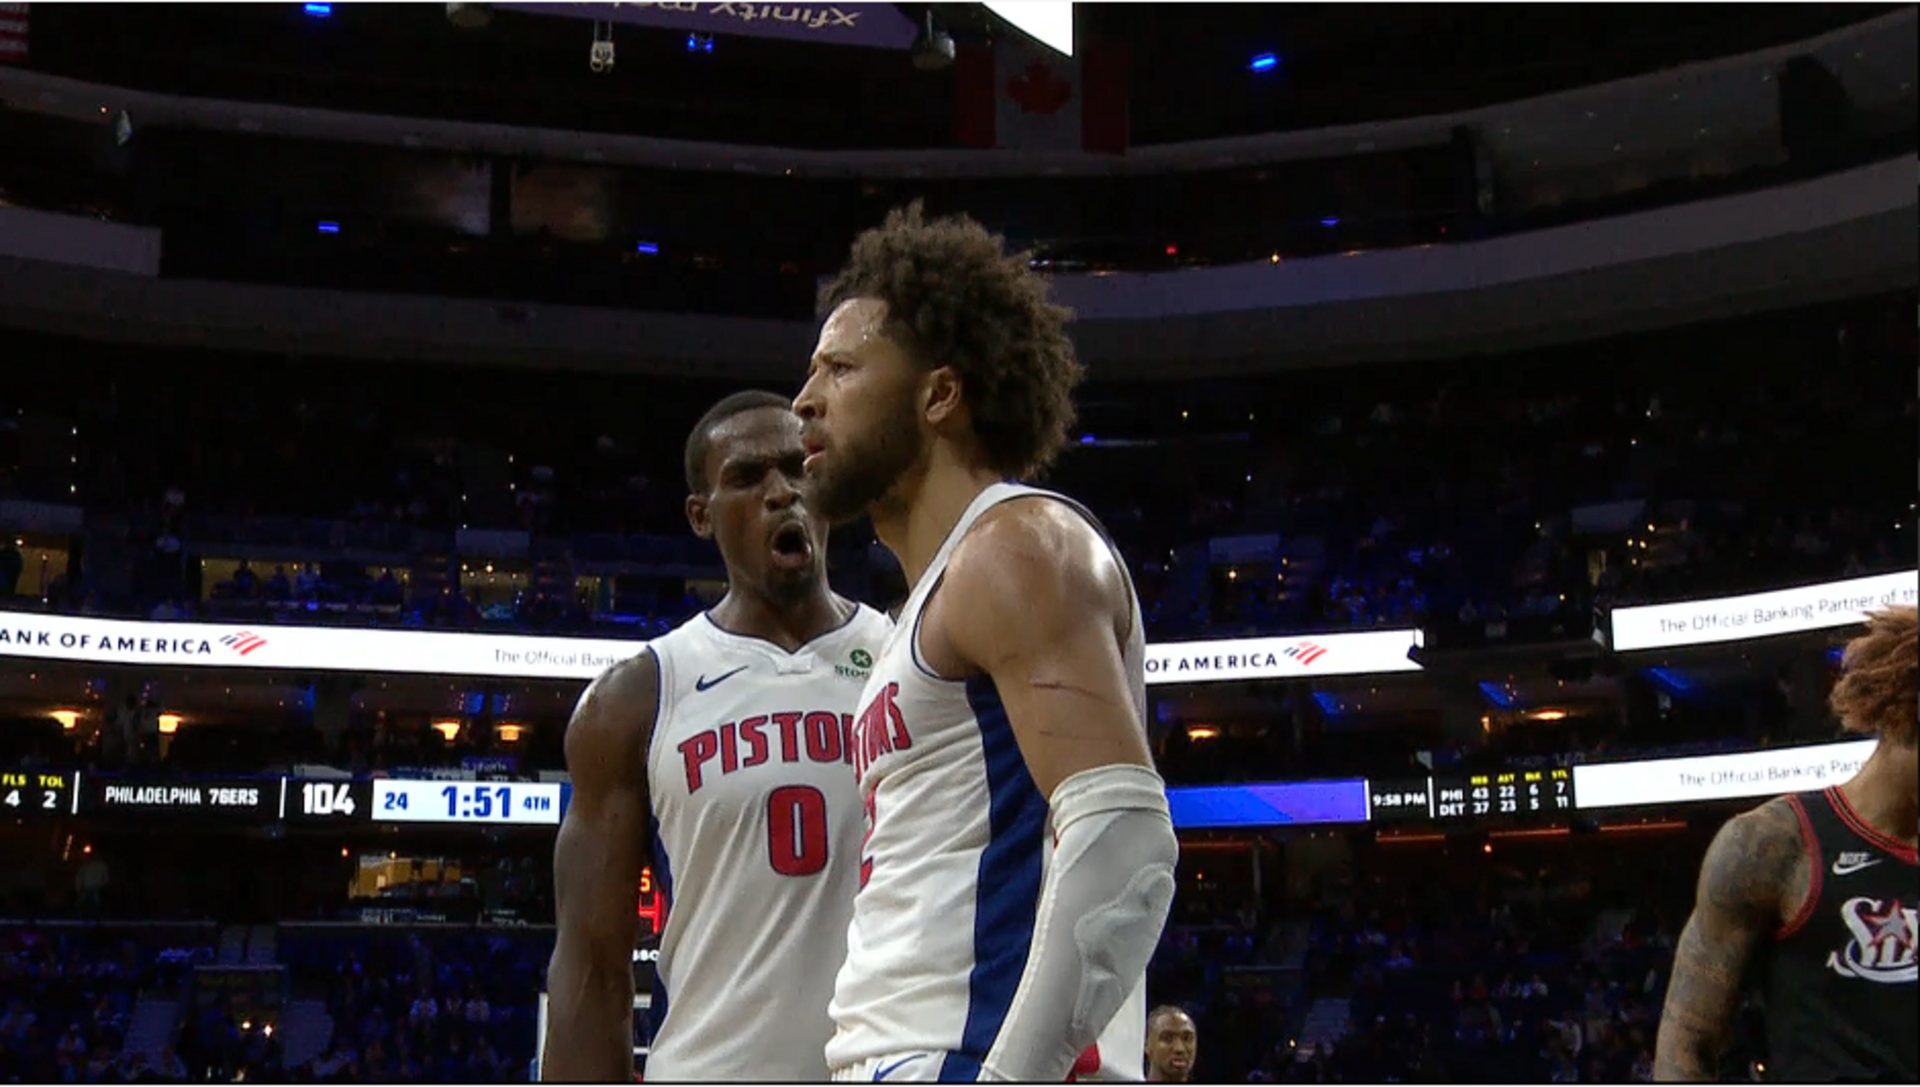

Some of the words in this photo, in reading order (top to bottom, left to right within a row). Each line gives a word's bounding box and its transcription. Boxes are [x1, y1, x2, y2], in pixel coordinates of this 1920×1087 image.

[1660, 619, 1687, 633] The
[1692, 613, 1747, 631] Official
[1753, 605, 1813, 626] Banking
[1819, 595, 1875, 614] Partner
[1880, 588, 1896, 606] of
[0, 628, 50, 646] ANK
[60, 633, 91, 650] OF
[98, 635, 212, 655] AMERICA
[495, 648, 520, 664] The
[524, 650, 577, 666] Official
[582, 652, 615, 667] Bank
[1146, 658, 1171, 674] OF
[1178, 653, 1278, 672] AMERICA
[677, 710, 854, 795] PISTO
[3, 774, 26, 787] FLS
[38, 775, 65, 788] TOL
[1680, 773, 1704, 787] The
[1711, 768, 1763, 785] Official
[1768, 764, 1826, 780] Banking
[5, 790, 21, 807] 4
[43, 791, 57, 808] 2
[105, 786, 201, 806] PHILADELPHIA
[209, 788, 259, 806] 76ERS
[302, 783, 356, 815] 104
[384, 792, 409, 810] 24
[441, 785, 512, 818] 1:51
[522, 796, 551, 811] 4TH
[1373, 793, 1401, 807] 9:58
[1404, 792, 1427, 806] PM
[1441, 789, 1463, 802] PHI
[1472, 787, 1489, 800] 43
[1499, 785, 1515, 798] 22
[1529, 783, 1539, 796] 6
[1556, 781, 1565, 794] 7
[1439, 803, 1465, 817] DET
[1473, 801, 1490, 815] 37
[1500, 799, 1517, 813] 23
[1530, 797, 1539, 810] 5
[1555, 796, 1568, 808] 11
[767, 785, 828, 876] 0
